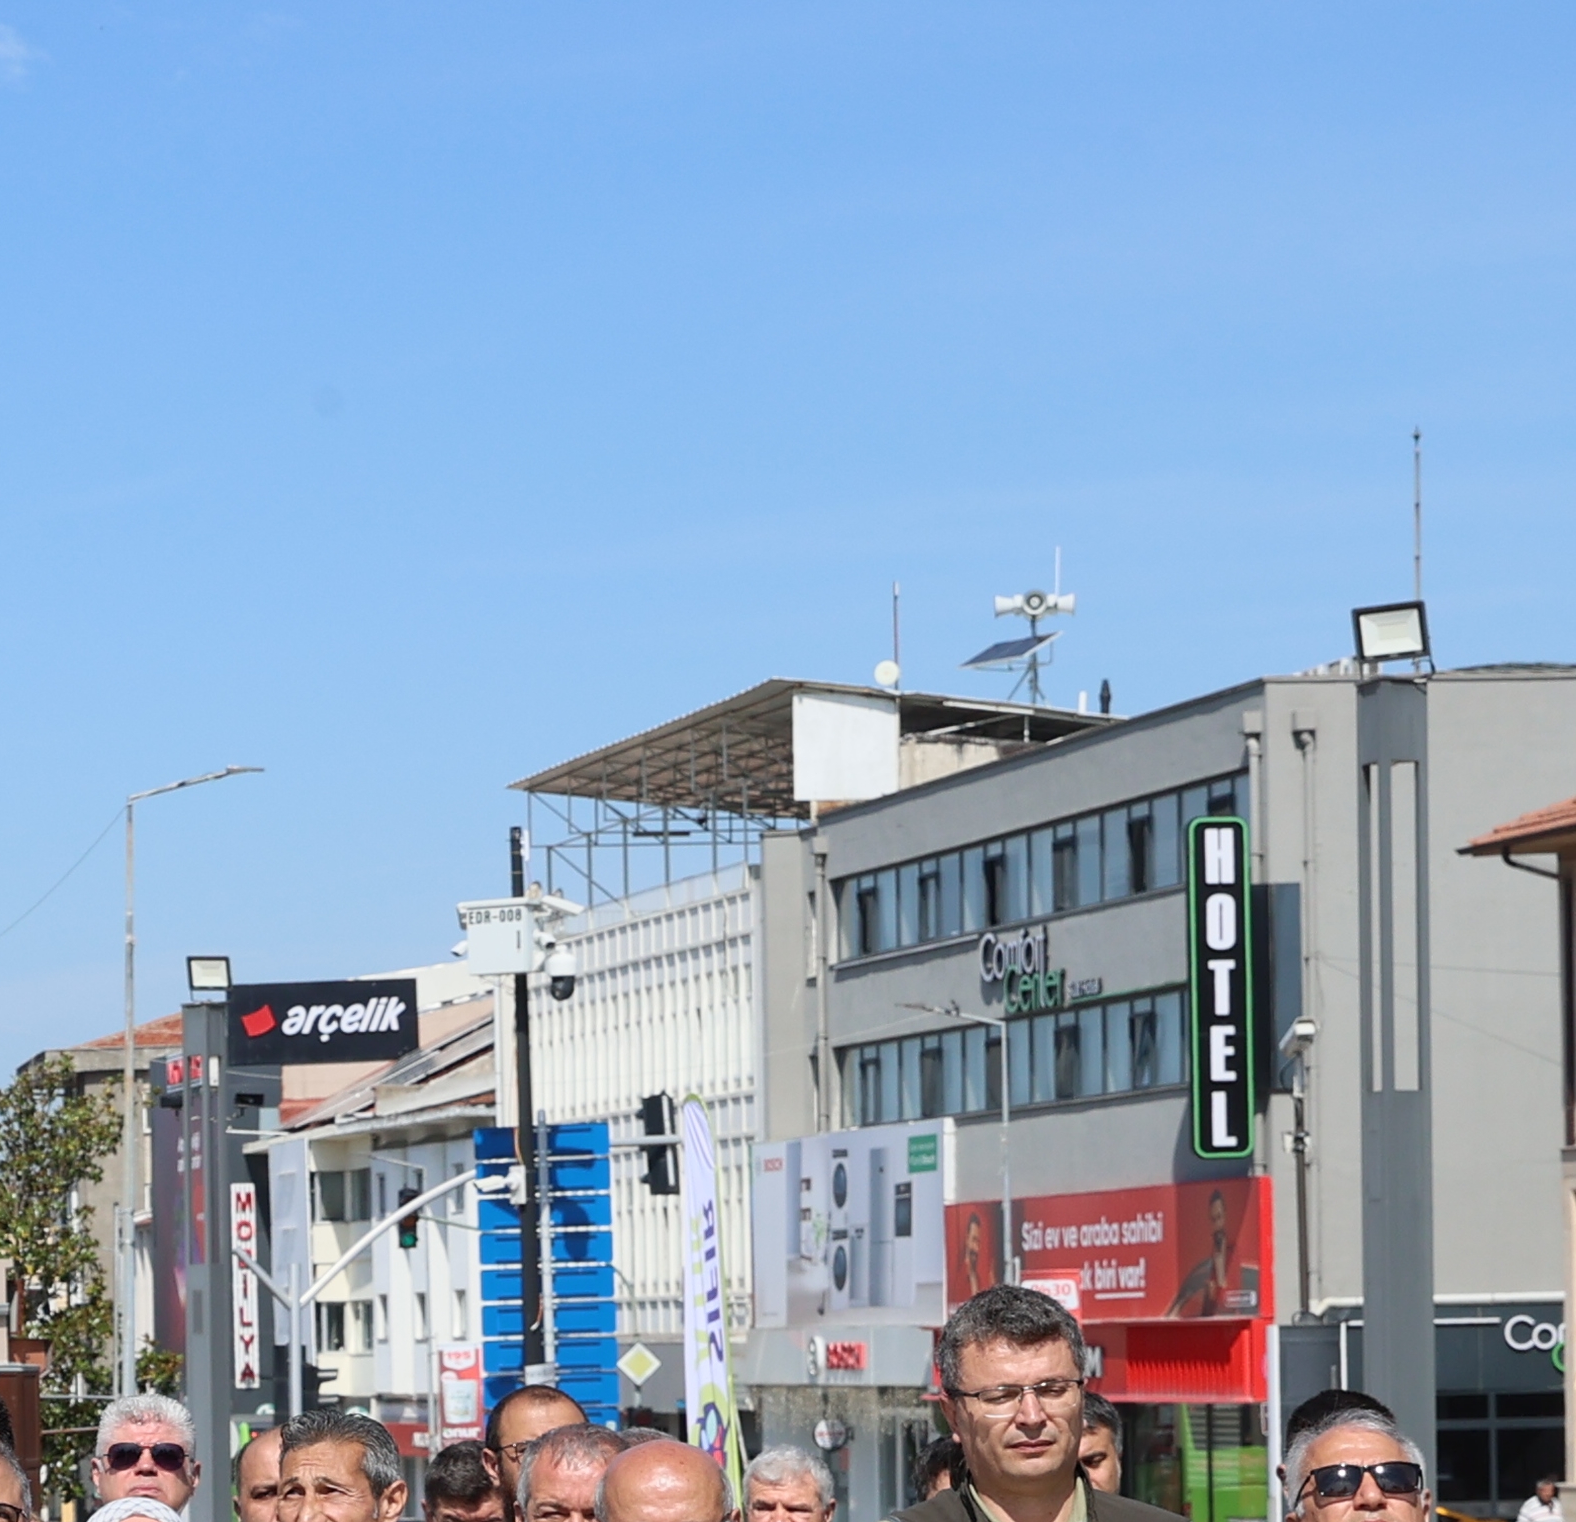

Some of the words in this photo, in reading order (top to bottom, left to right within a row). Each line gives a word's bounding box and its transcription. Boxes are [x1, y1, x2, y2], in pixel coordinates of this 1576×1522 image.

[468, 908, 522, 924] EDR-008
[979, 924, 1046, 984] Comfort
[1004, 964, 1065, 1013] Center
[1204, 827, 1238, 1148] HOTEL
[281, 996, 406, 1043] arçelik
[1021, 1221, 1044, 1251] Sizi
[1044, 1228, 1061, 1249] ev
[1062, 1227, 1079, 1248] ve
[1080, 1216, 1120, 1247] araba
[1121, 1212, 1164, 1243] sahibi
[1095, 1259, 1117, 1290] biri
[1118, 1257, 1146, 1290] var!
